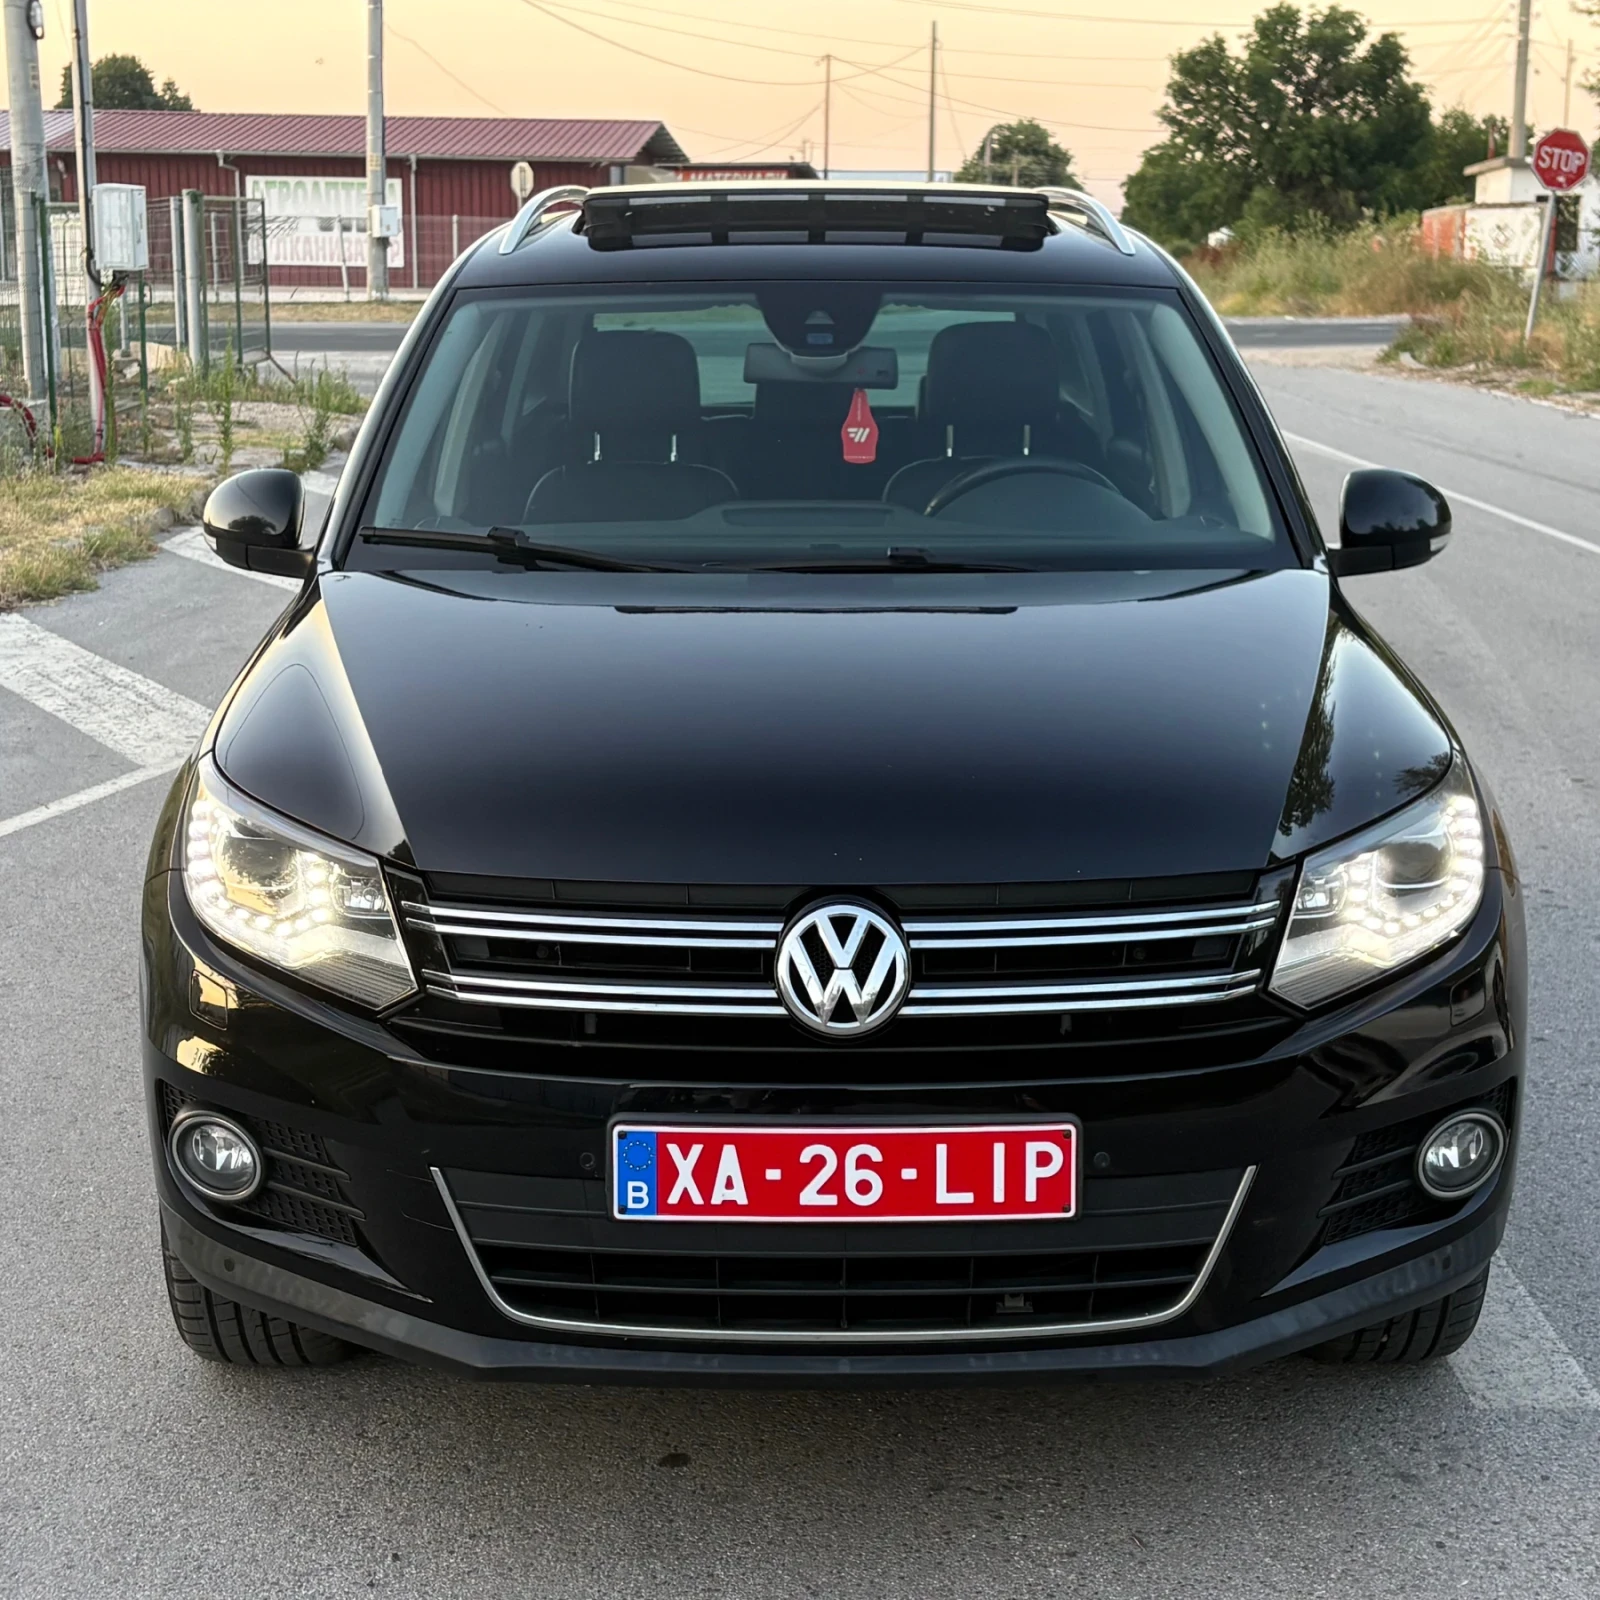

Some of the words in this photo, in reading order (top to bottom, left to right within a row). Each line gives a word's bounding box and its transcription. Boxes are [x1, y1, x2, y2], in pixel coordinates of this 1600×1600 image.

[1538, 146, 1585, 173] STOP
[252, 180, 398, 216] АГРОАПТЕА
[627, 1182, 649, 1209] B
